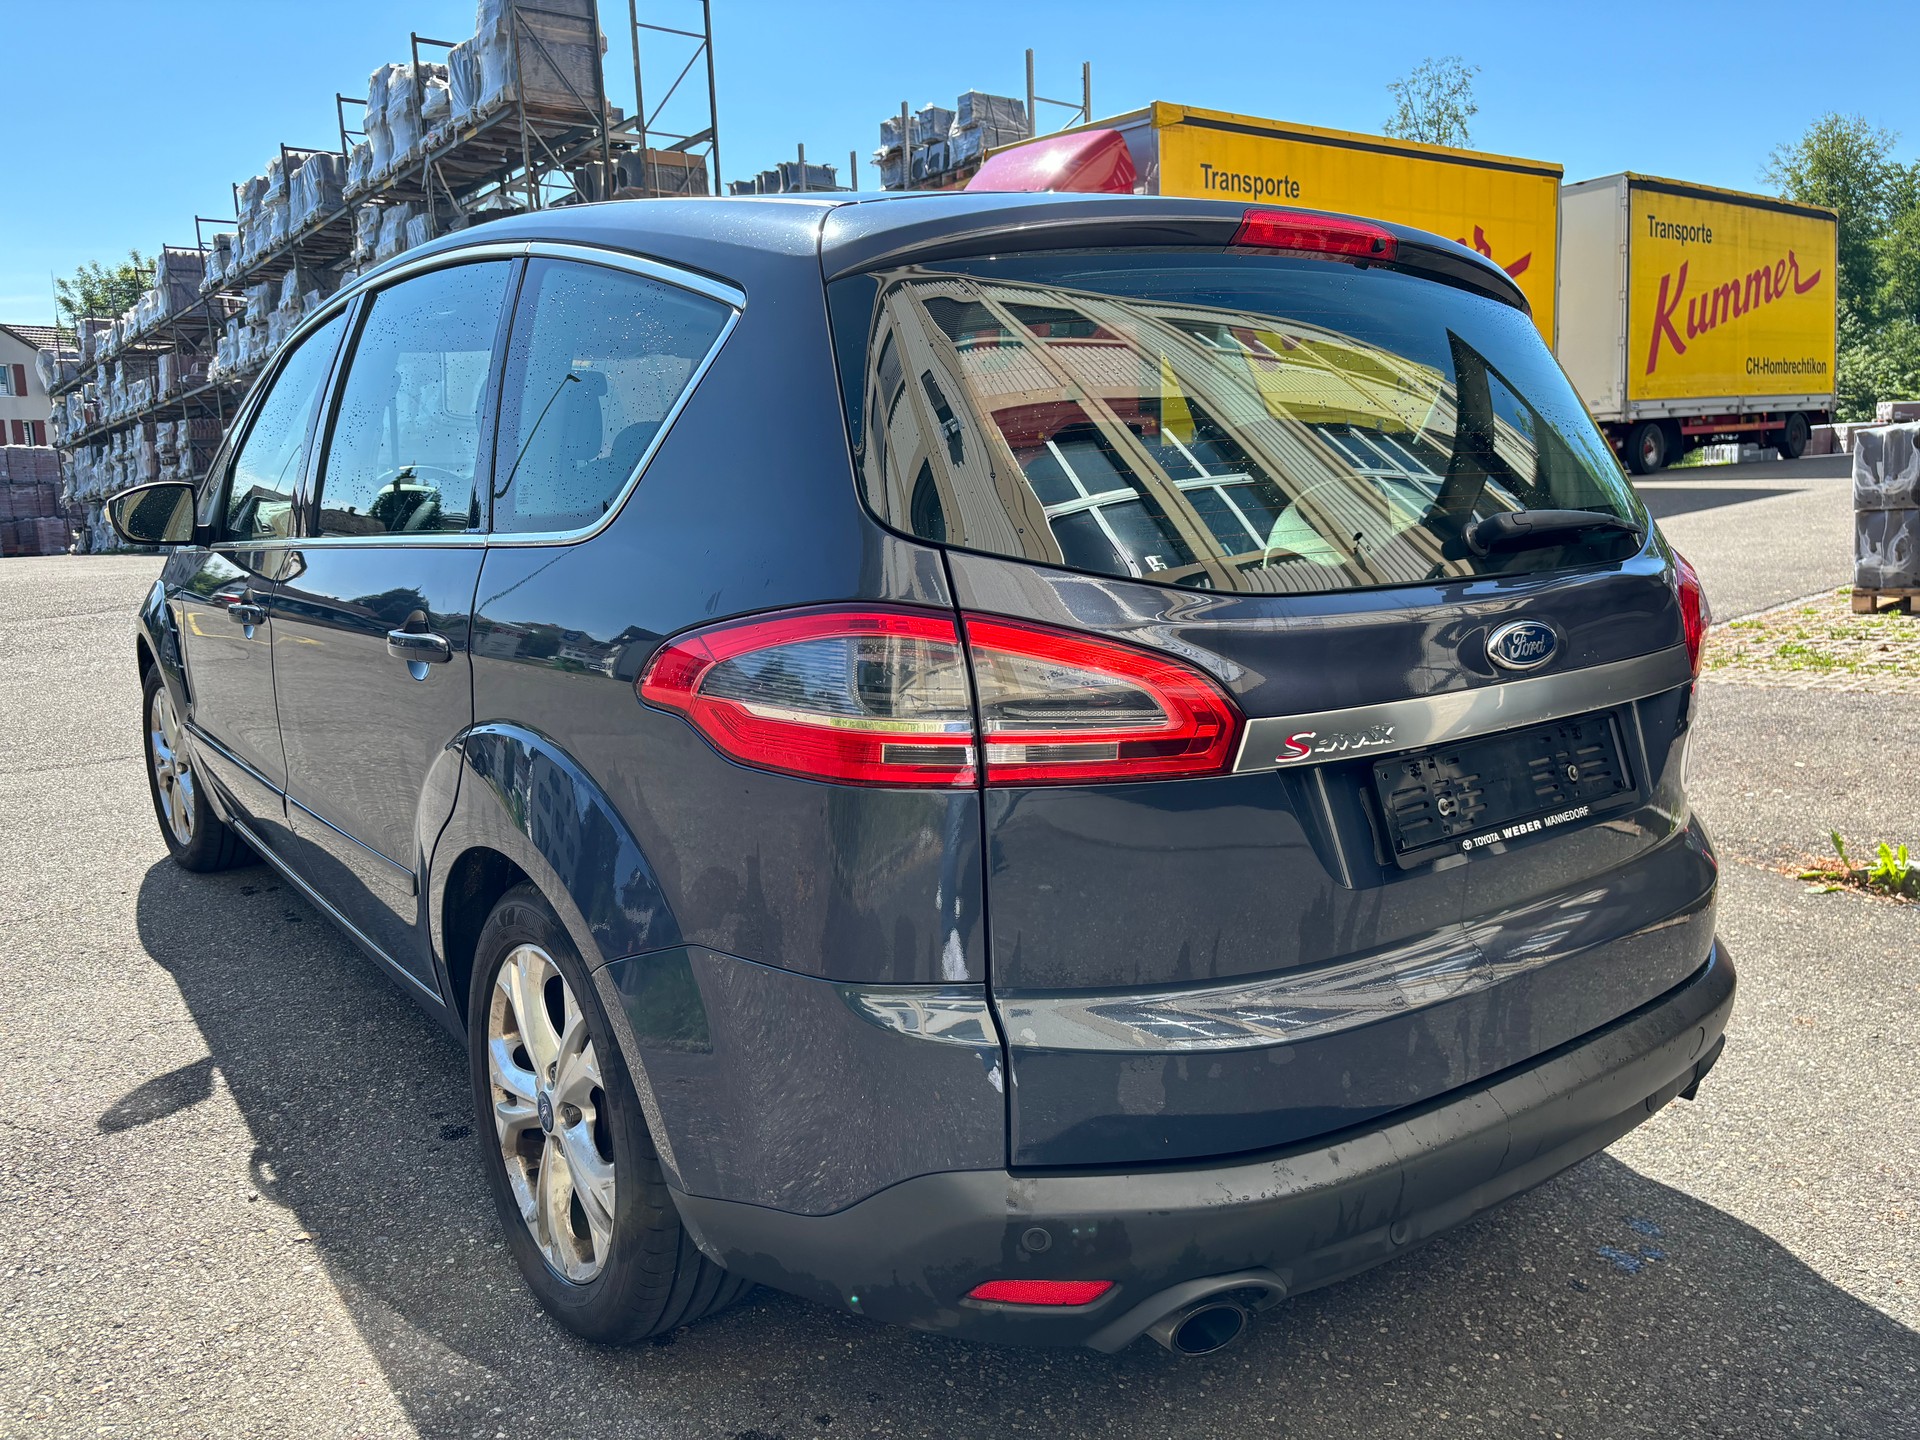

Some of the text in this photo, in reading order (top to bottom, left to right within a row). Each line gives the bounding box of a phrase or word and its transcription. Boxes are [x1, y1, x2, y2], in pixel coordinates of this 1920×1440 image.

[1200, 163, 1300, 201] Transporte
[1647, 214, 1713, 246] Transporte
[1645, 249, 1822, 377] Kummer
[1745, 356, 1827, 375] CH-Hombrechtikon
[1511, 629, 1546, 659] Ford
[1472, 805, 1589, 847] TOYOTA WEBER MÄNNEDORF
